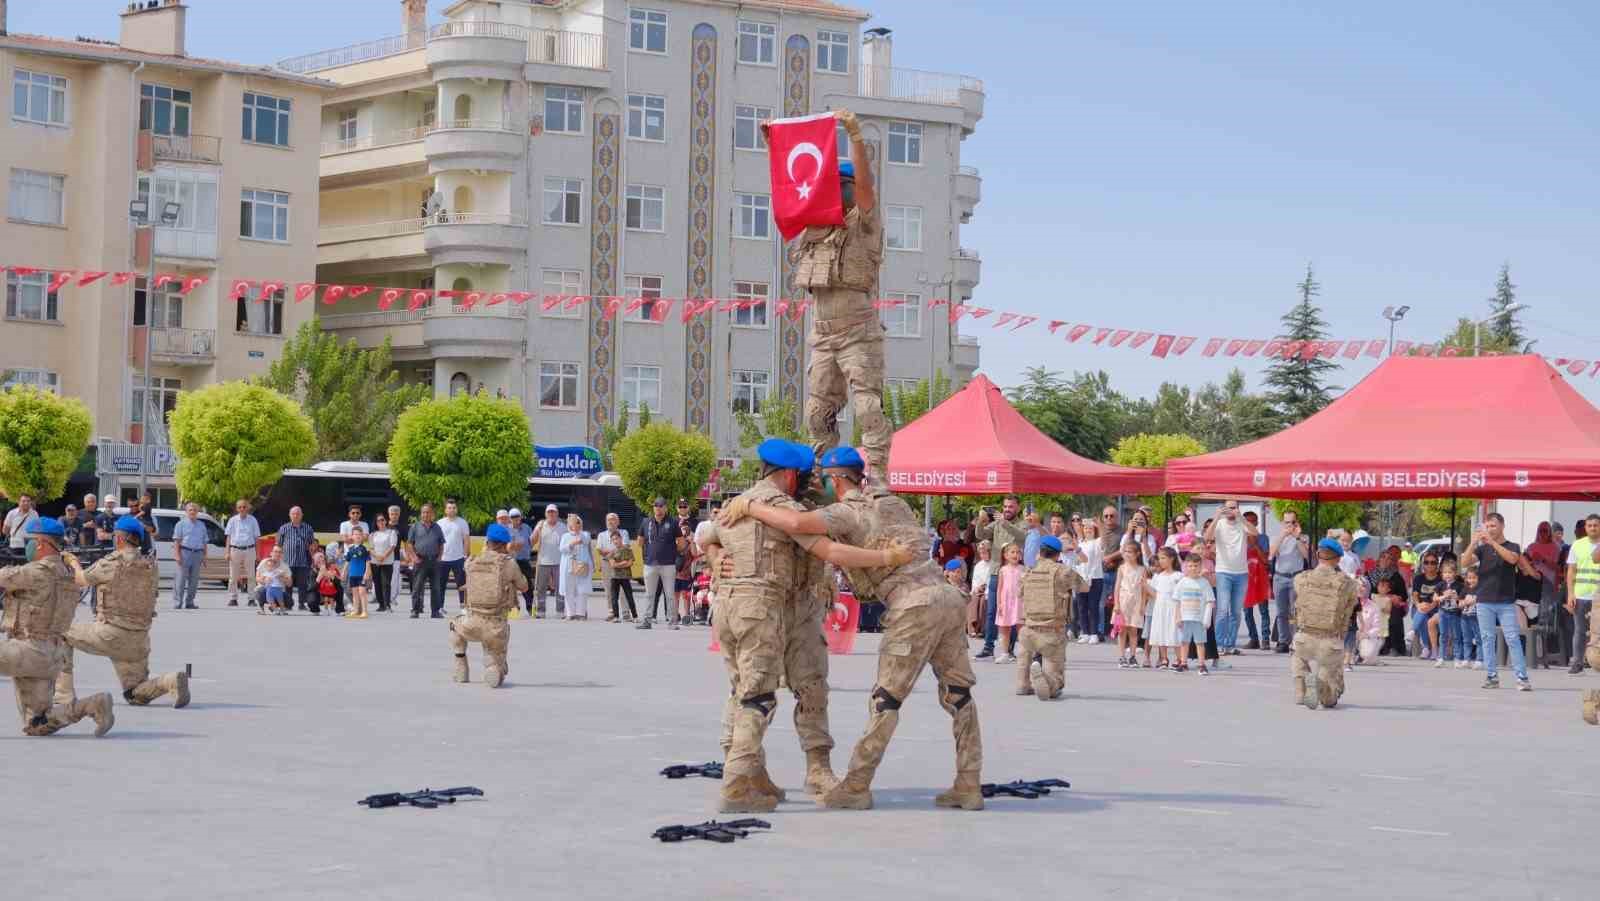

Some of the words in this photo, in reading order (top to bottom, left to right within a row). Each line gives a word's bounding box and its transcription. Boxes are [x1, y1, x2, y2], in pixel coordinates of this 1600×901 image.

[535, 453, 598, 469] araklar.
[889, 469, 967, 487] BELEDİYESİ
[1290, 472, 1377, 488] KARAMAN
[1381, 468, 1487, 488] BELEDİYESİ
